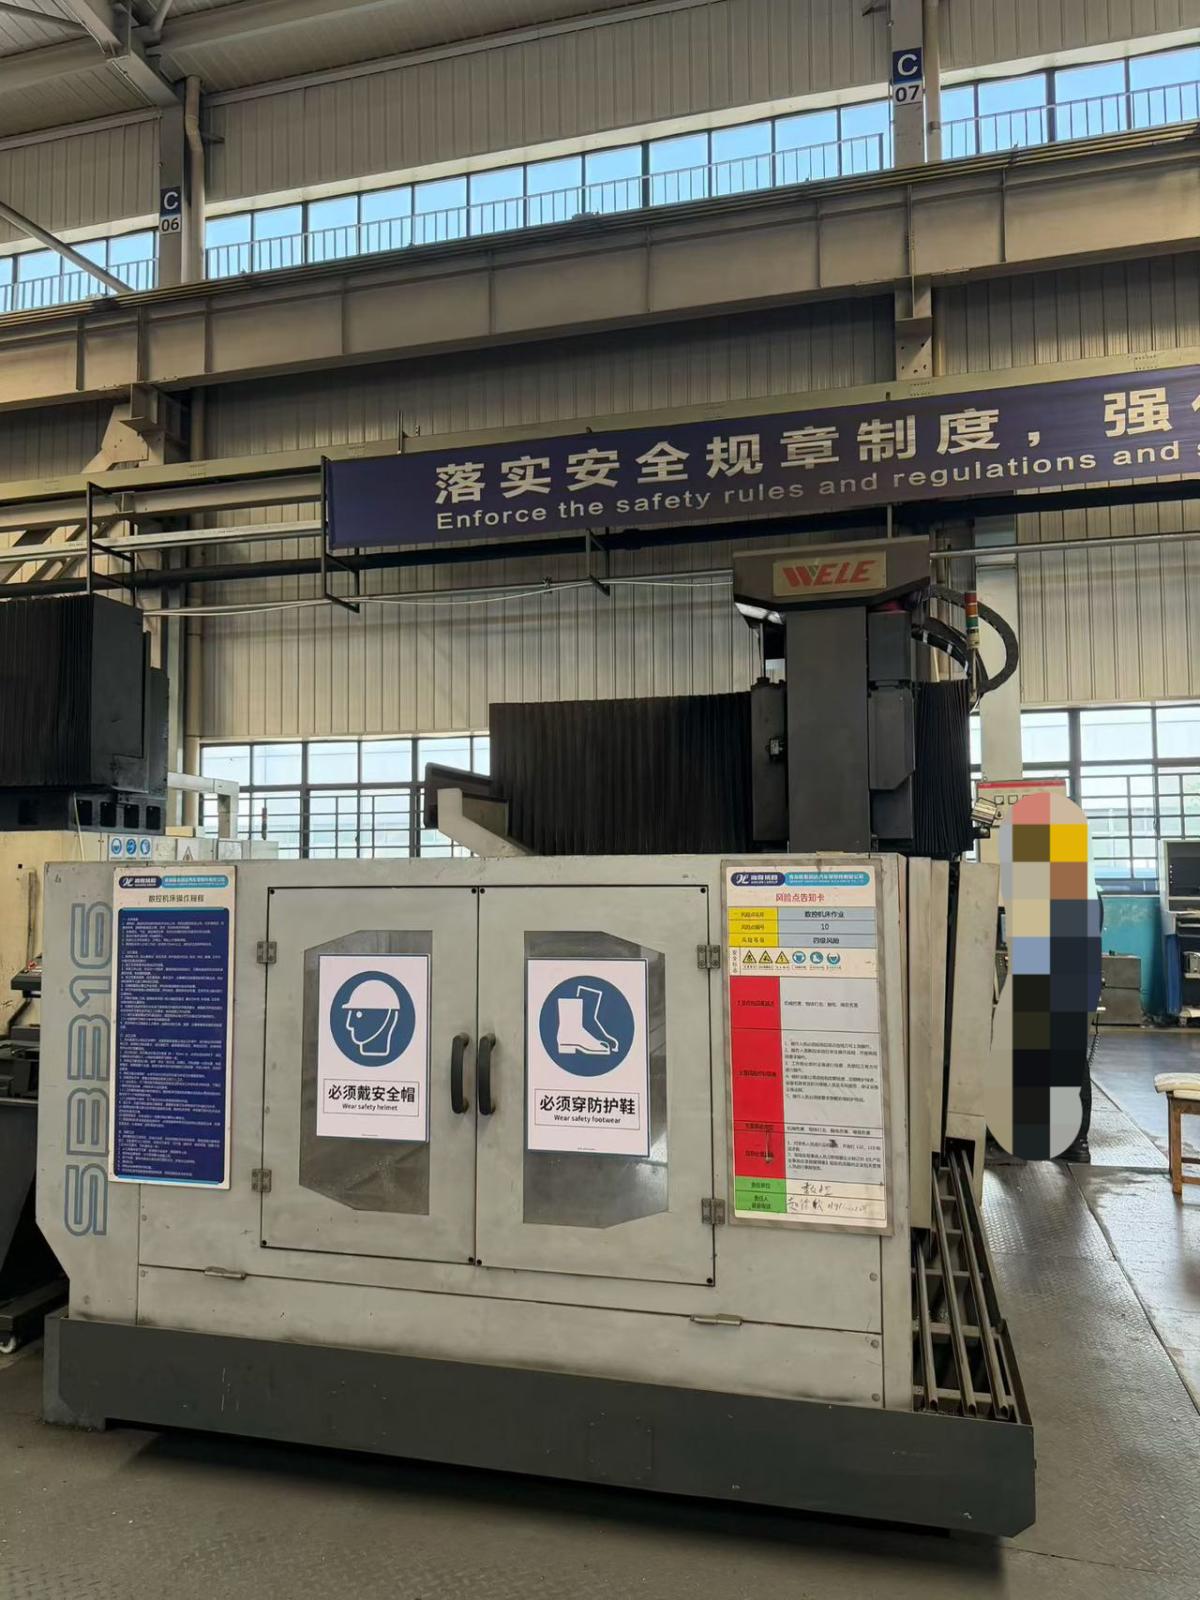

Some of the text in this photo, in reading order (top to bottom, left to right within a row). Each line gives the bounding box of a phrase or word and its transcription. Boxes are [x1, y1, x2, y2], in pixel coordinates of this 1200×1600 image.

[897, 53, 918, 76] C
[895, 85, 920, 102] 07
[163, 191, 178, 209] C
[161, 217, 179, 232] 06
[437, 508, 547, 530] Enforce
[558, 501, 604, 518] the
[616, 490, 711, 513] safety
[724, 483, 804, 504] rules
[819, 473, 878, 495] and
[893, 453, 1097, 488] regulations
[1113, 440, 1179, 465] and
[782, 560, 876, 588] WELE
[821, 923, 830, 931] 10
[328, 1084, 416, 1103] 必须戴安全帽
[358, 1103, 376, 1111] safety
[539, 1094, 636, 1115] 必须穿防护鞋
[571, 1115, 591, 1123] safety
